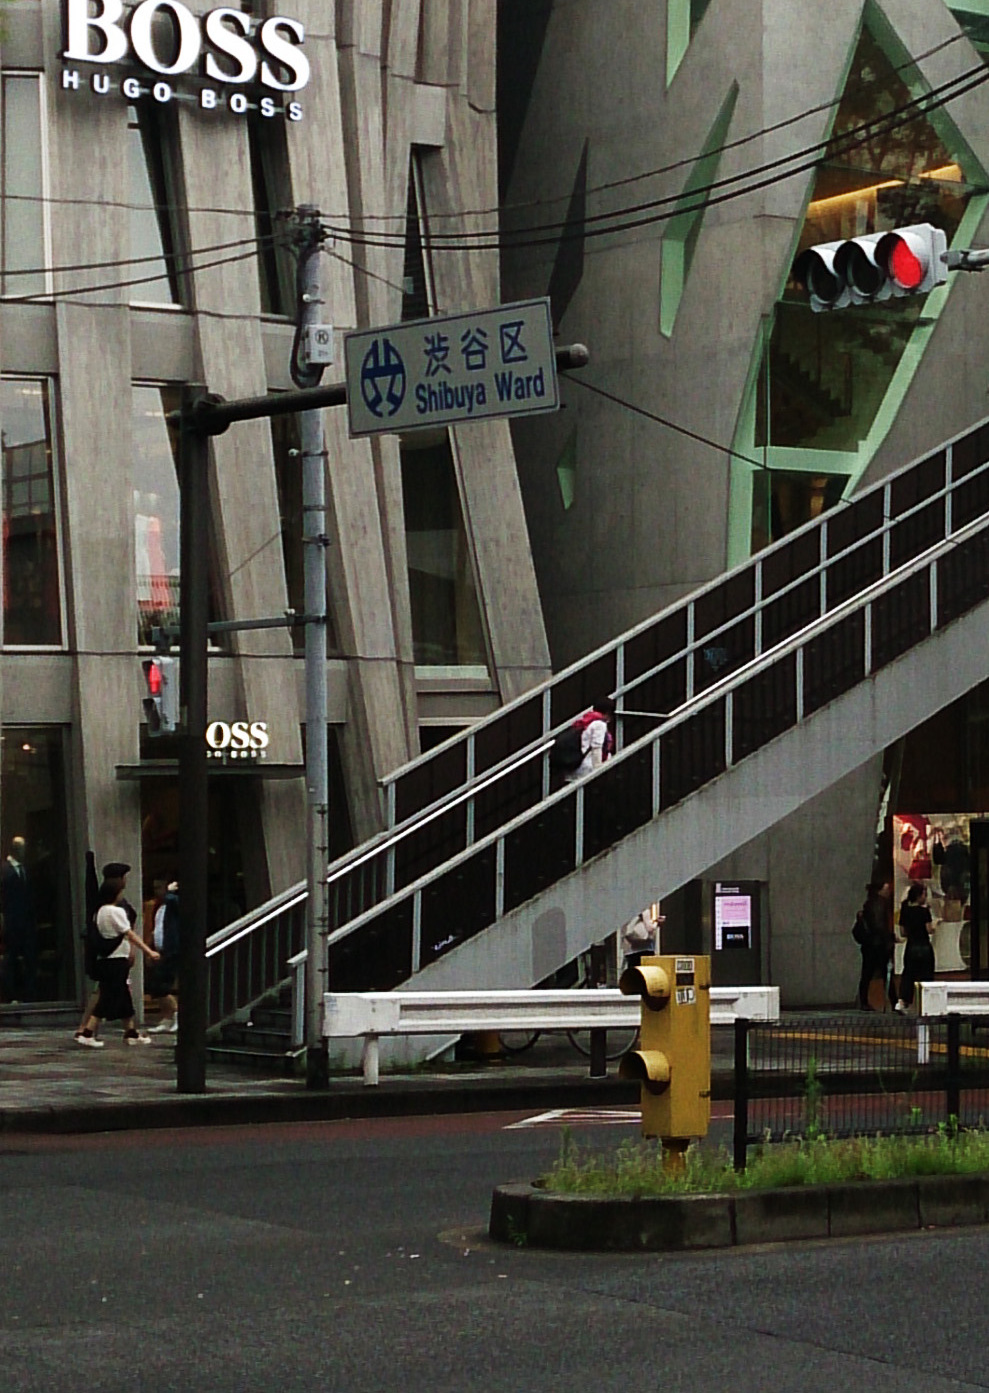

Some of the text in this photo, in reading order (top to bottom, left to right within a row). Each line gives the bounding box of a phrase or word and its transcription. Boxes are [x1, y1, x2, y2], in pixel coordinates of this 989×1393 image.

[62, 68, 304, 122] HUGO BOSS
[423, 320, 529, 377] 渋谷区
[415, 366, 545, 415] Shibuya Ward
[206, 721, 269, 749] OSS
